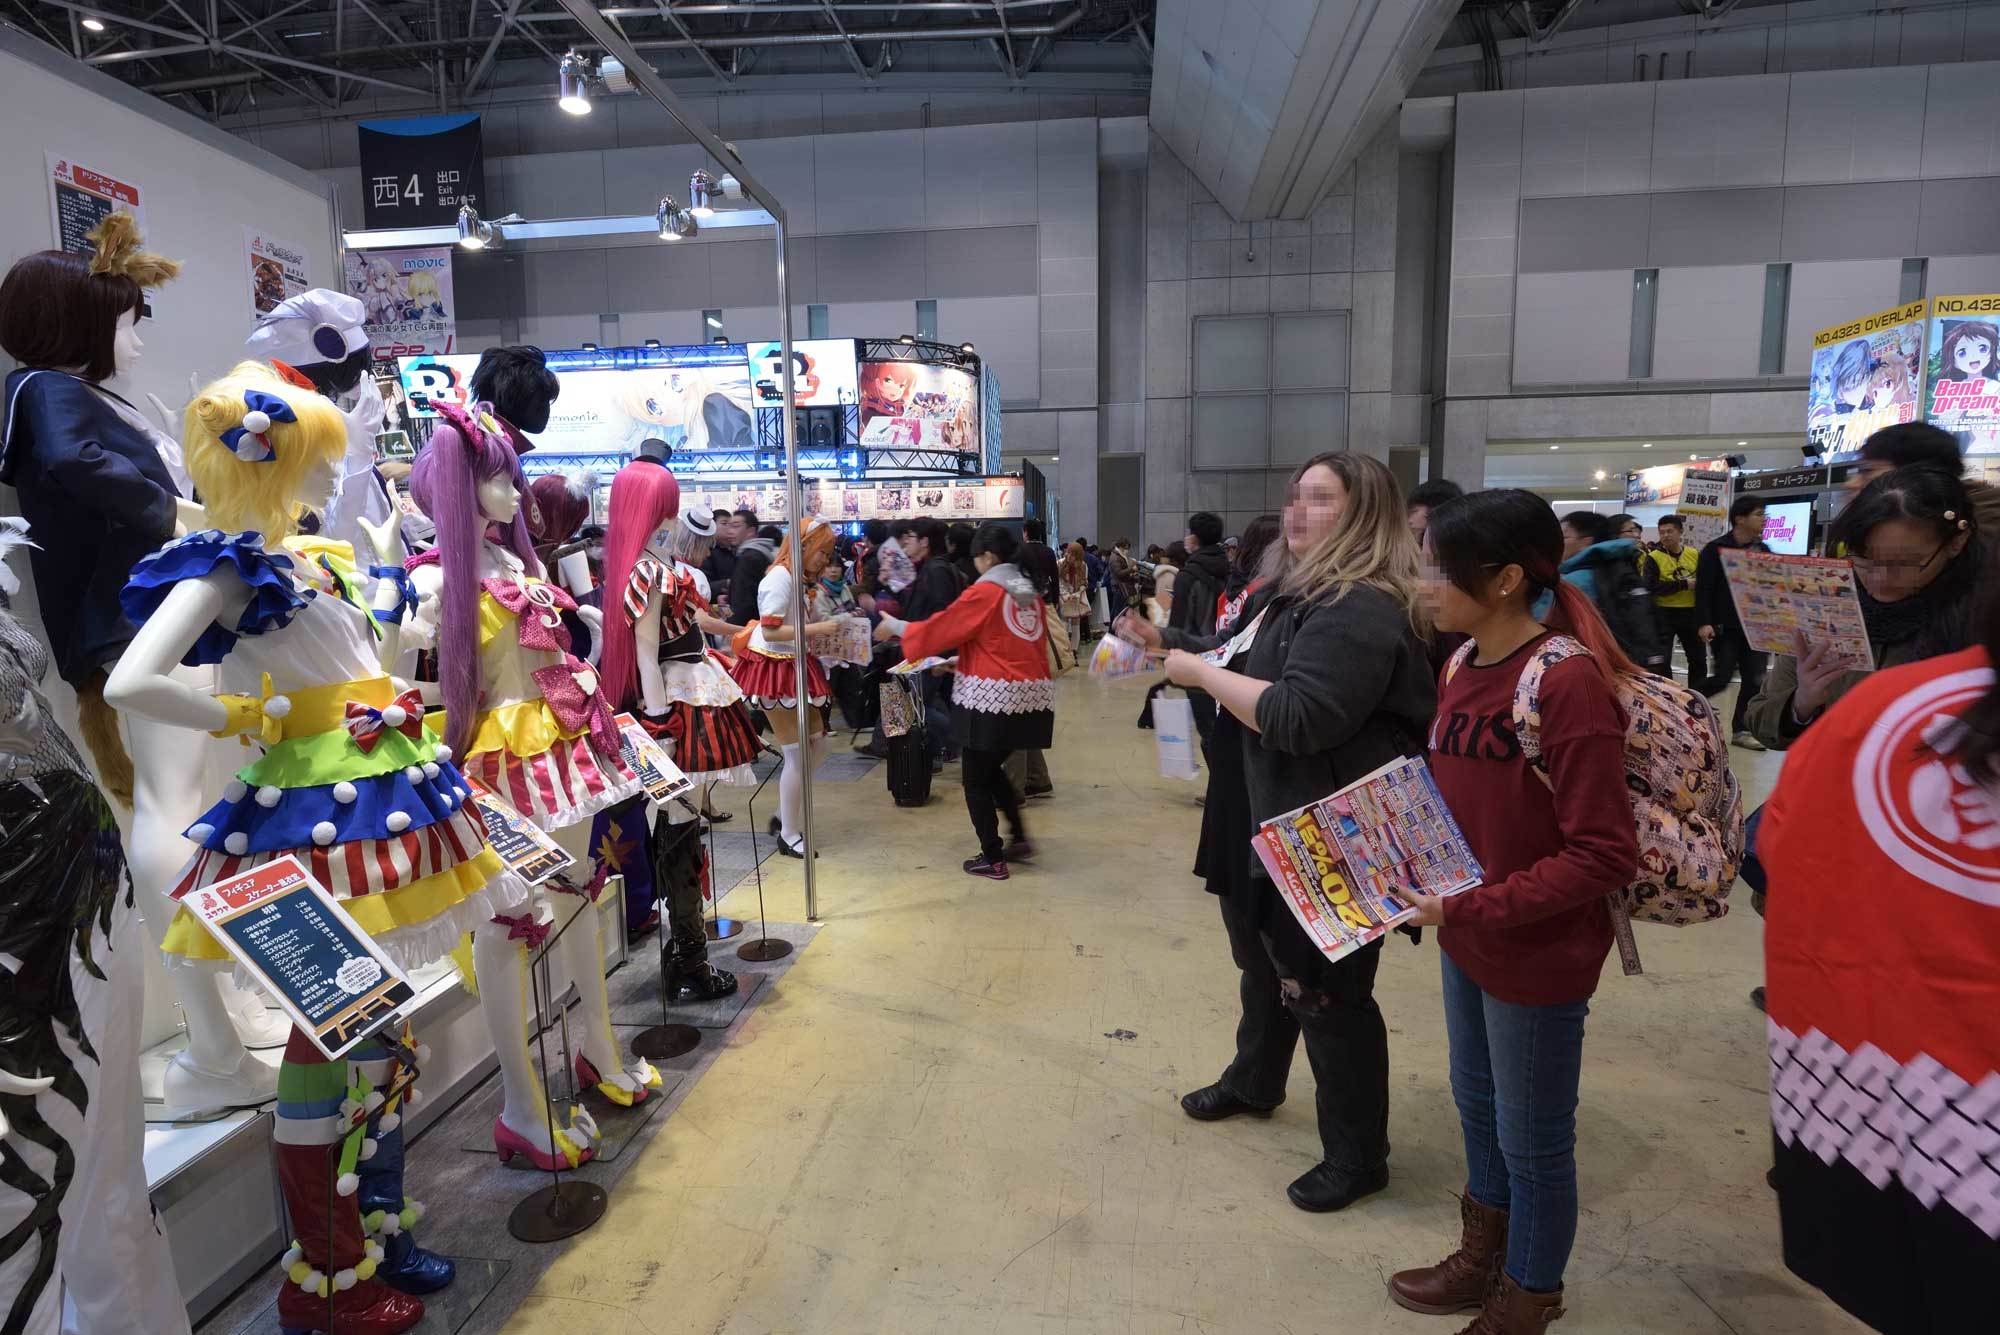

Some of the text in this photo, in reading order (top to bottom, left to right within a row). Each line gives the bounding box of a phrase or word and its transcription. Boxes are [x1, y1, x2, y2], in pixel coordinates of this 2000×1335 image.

[437, 170, 460, 184] 出口
[438, 185, 453, 195] Exit
[1814, 323, 1861, 346] NO.4323
[1864, 304, 1923, 331] OVERLAP
[1743, 471, 1818, 490] 4323 オーバーラップ
[1685, 492, 1719, 507] 最後尾
